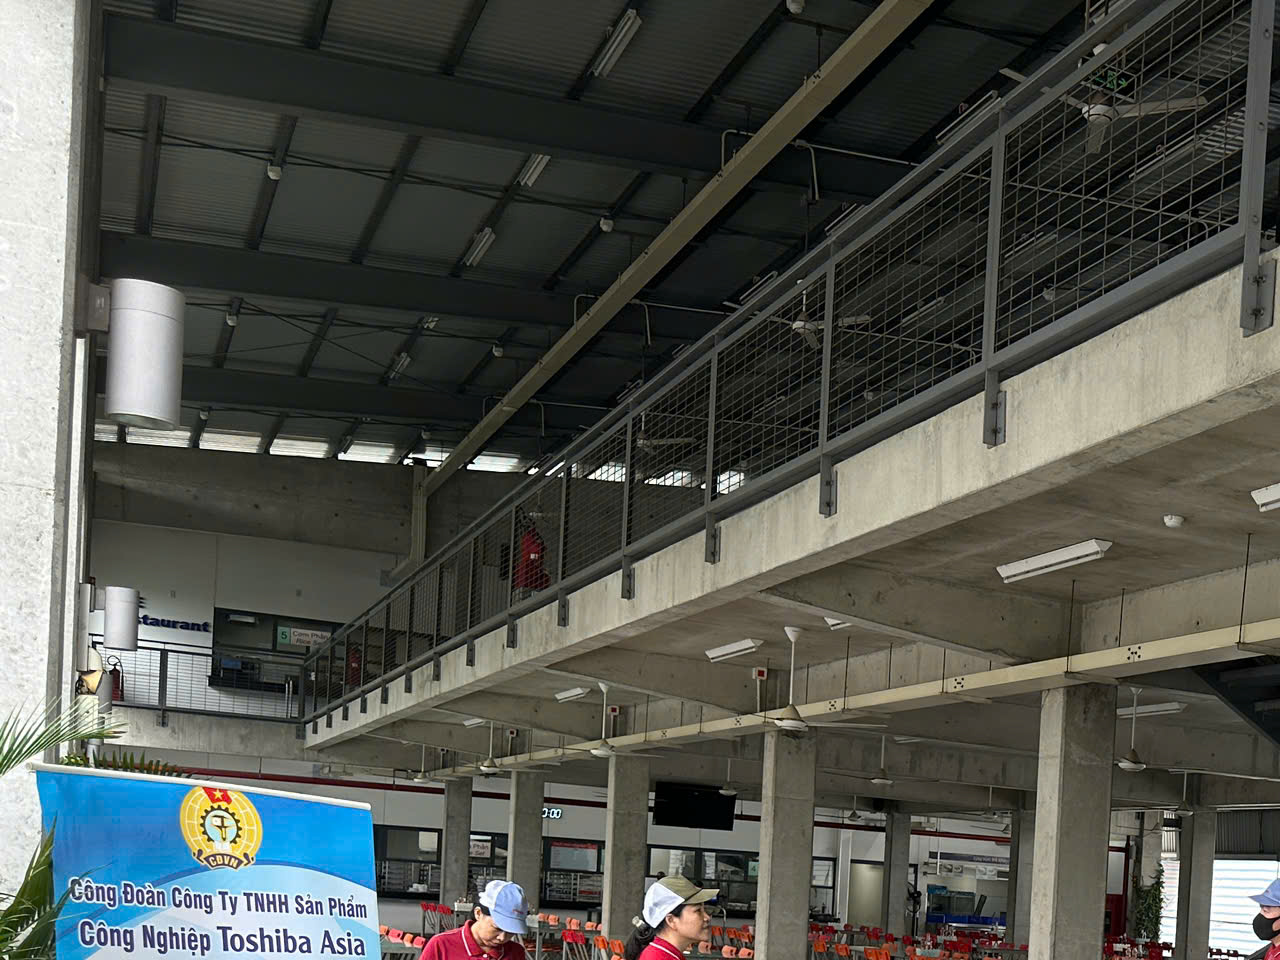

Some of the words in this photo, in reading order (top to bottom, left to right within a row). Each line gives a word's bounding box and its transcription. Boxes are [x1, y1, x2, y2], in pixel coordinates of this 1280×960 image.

[139, 615, 211, 633] taurant
[281, 631, 288, 640] 5
[70, 877, 117, 906] Công
[121, 881, 166, 908] Đoàn
[172, 886, 214, 914] Công
[218, 891, 238, 915] Ty
[244, 892, 290, 914] TNHH
[295, 893, 324, 917] Sản
[328, 894, 368, 919] Phẩm
[79, 920, 134, 953] Công
[142, 925, 211, 956] Nghiệp
[217, 926, 312, 954] Toshiba
[320, 930, 366, 956] Asia
